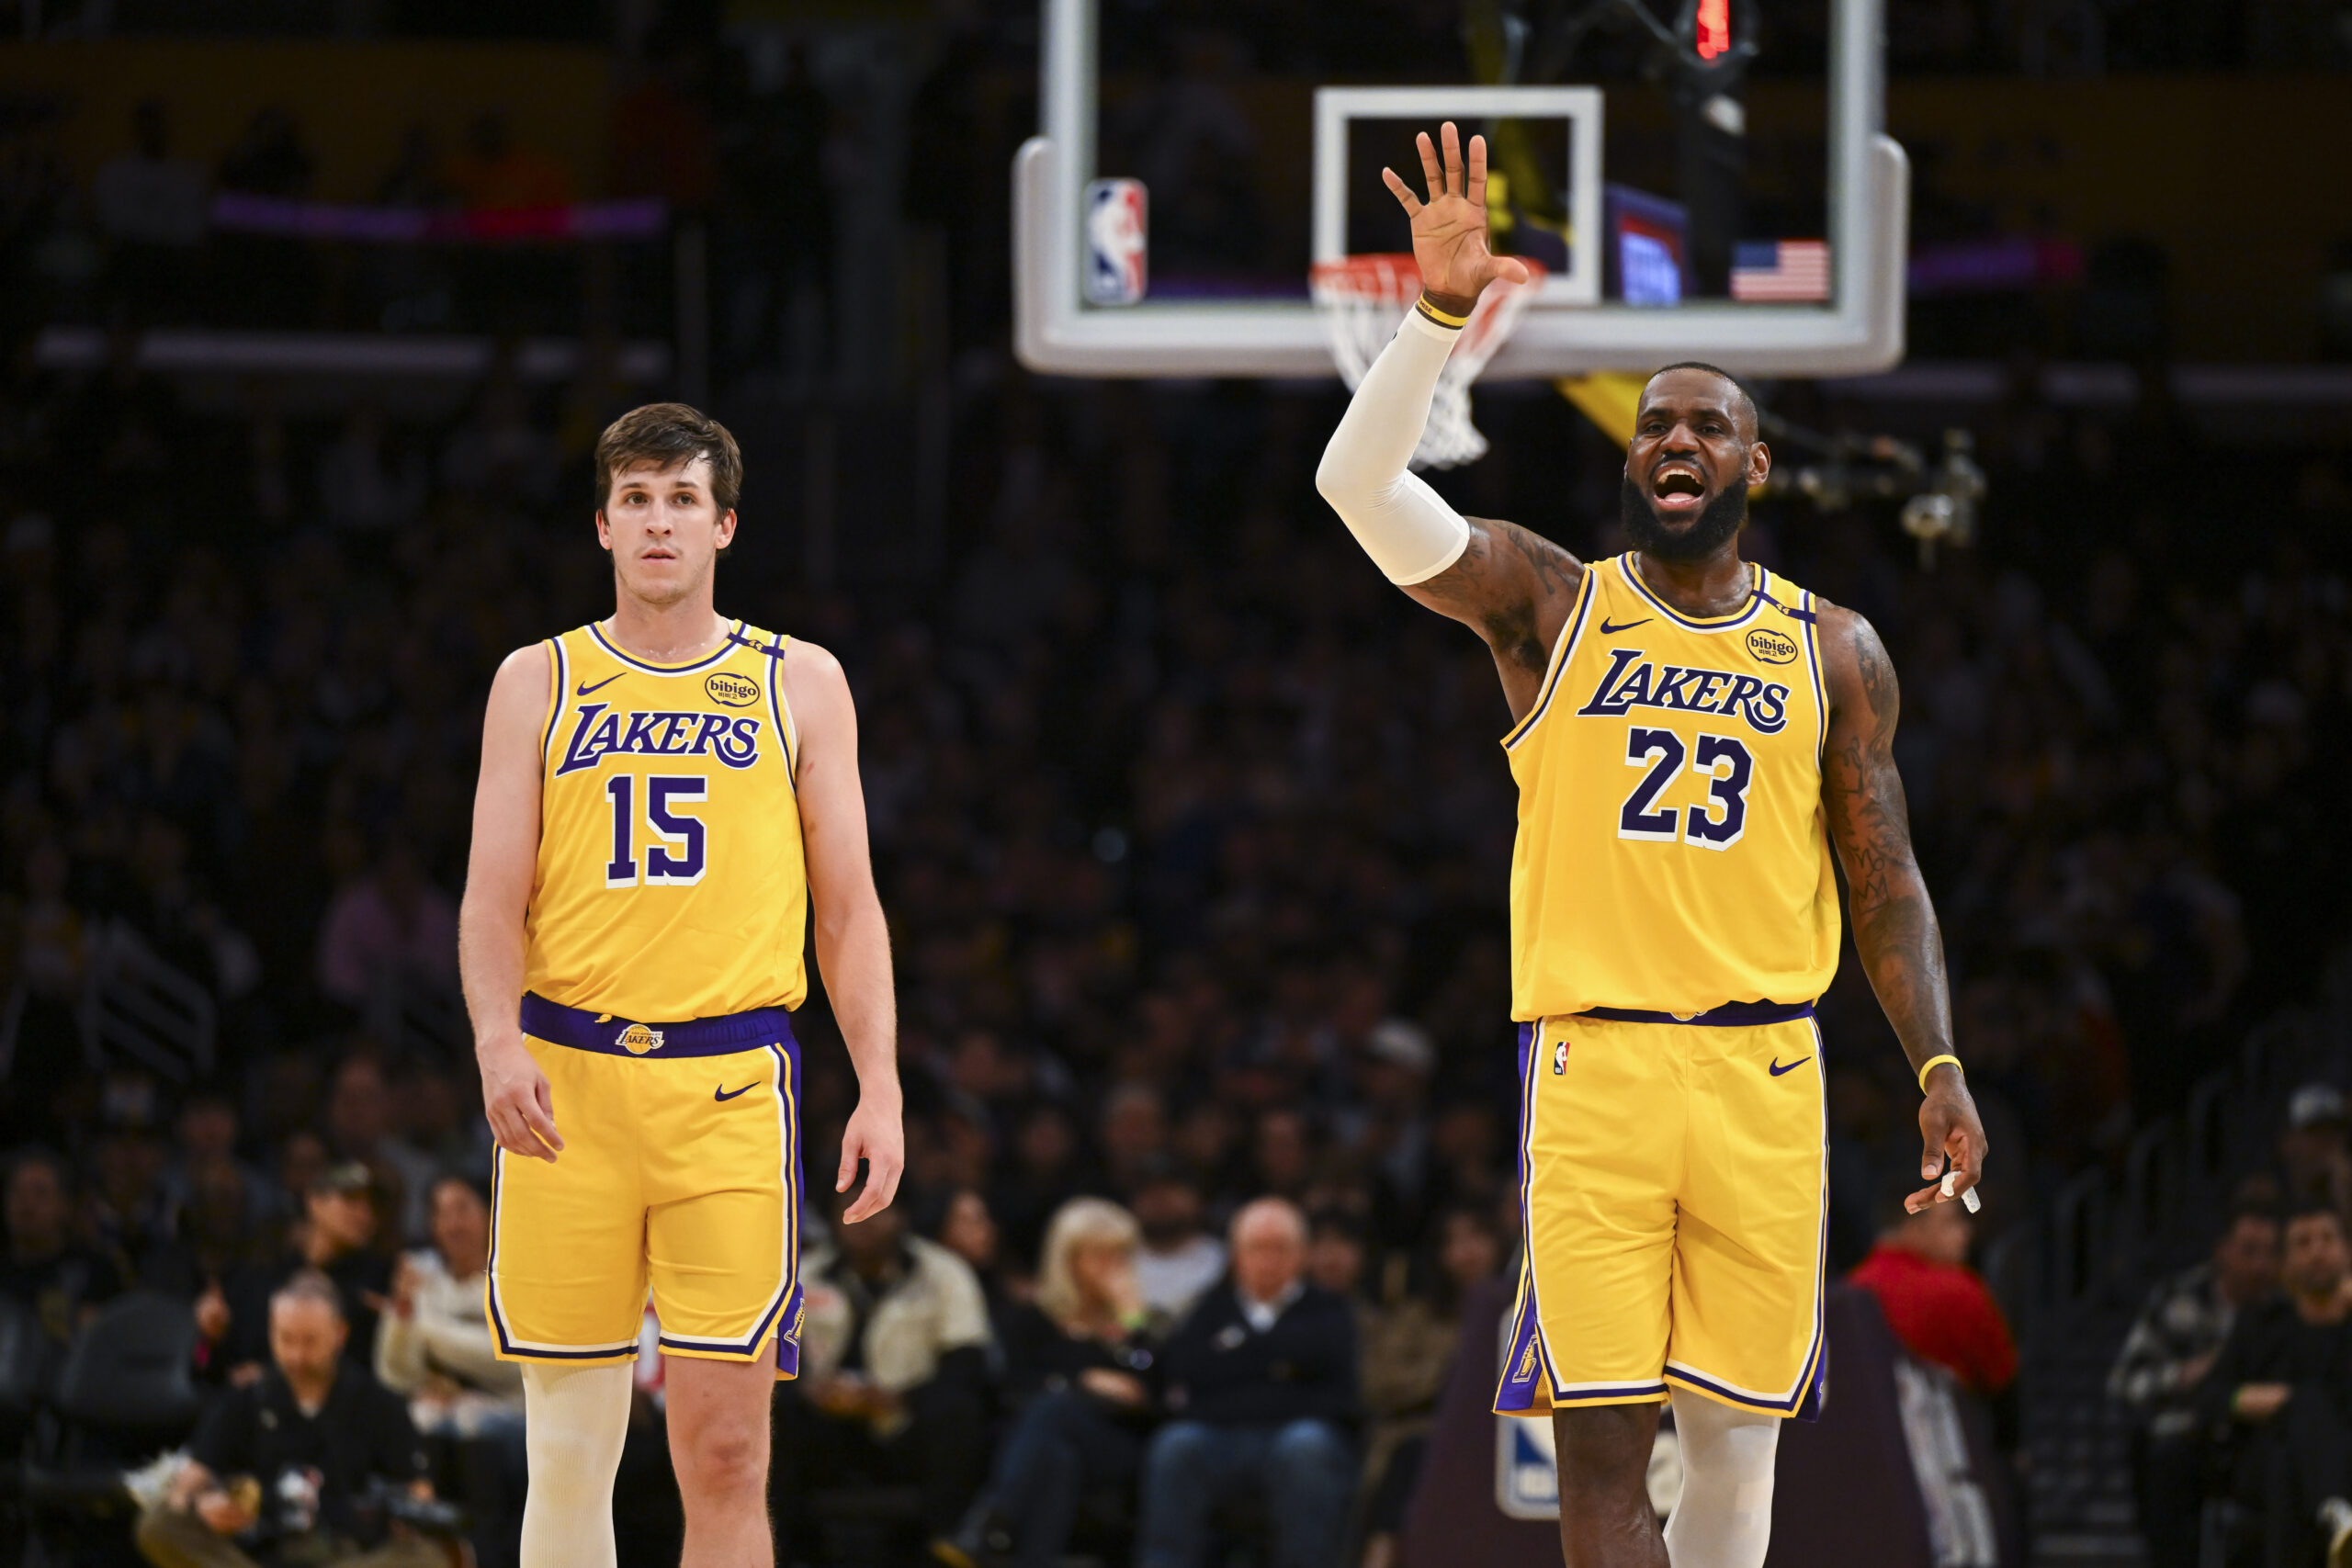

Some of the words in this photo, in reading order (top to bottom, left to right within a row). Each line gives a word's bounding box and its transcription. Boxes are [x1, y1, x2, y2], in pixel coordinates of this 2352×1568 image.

[1750, 636, 1795, 656] bibigo
[1758, 648, 1778, 658] 비비고
[710, 679, 757, 698] bibigo
[1575, 648, 1792, 735] LAKERS
[553, 701, 761, 779] LAKERS
[1617, 724, 1755, 852] 23
[605, 773, 708, 890] 15
[616, 1030, 663, 1049] LAKERS
